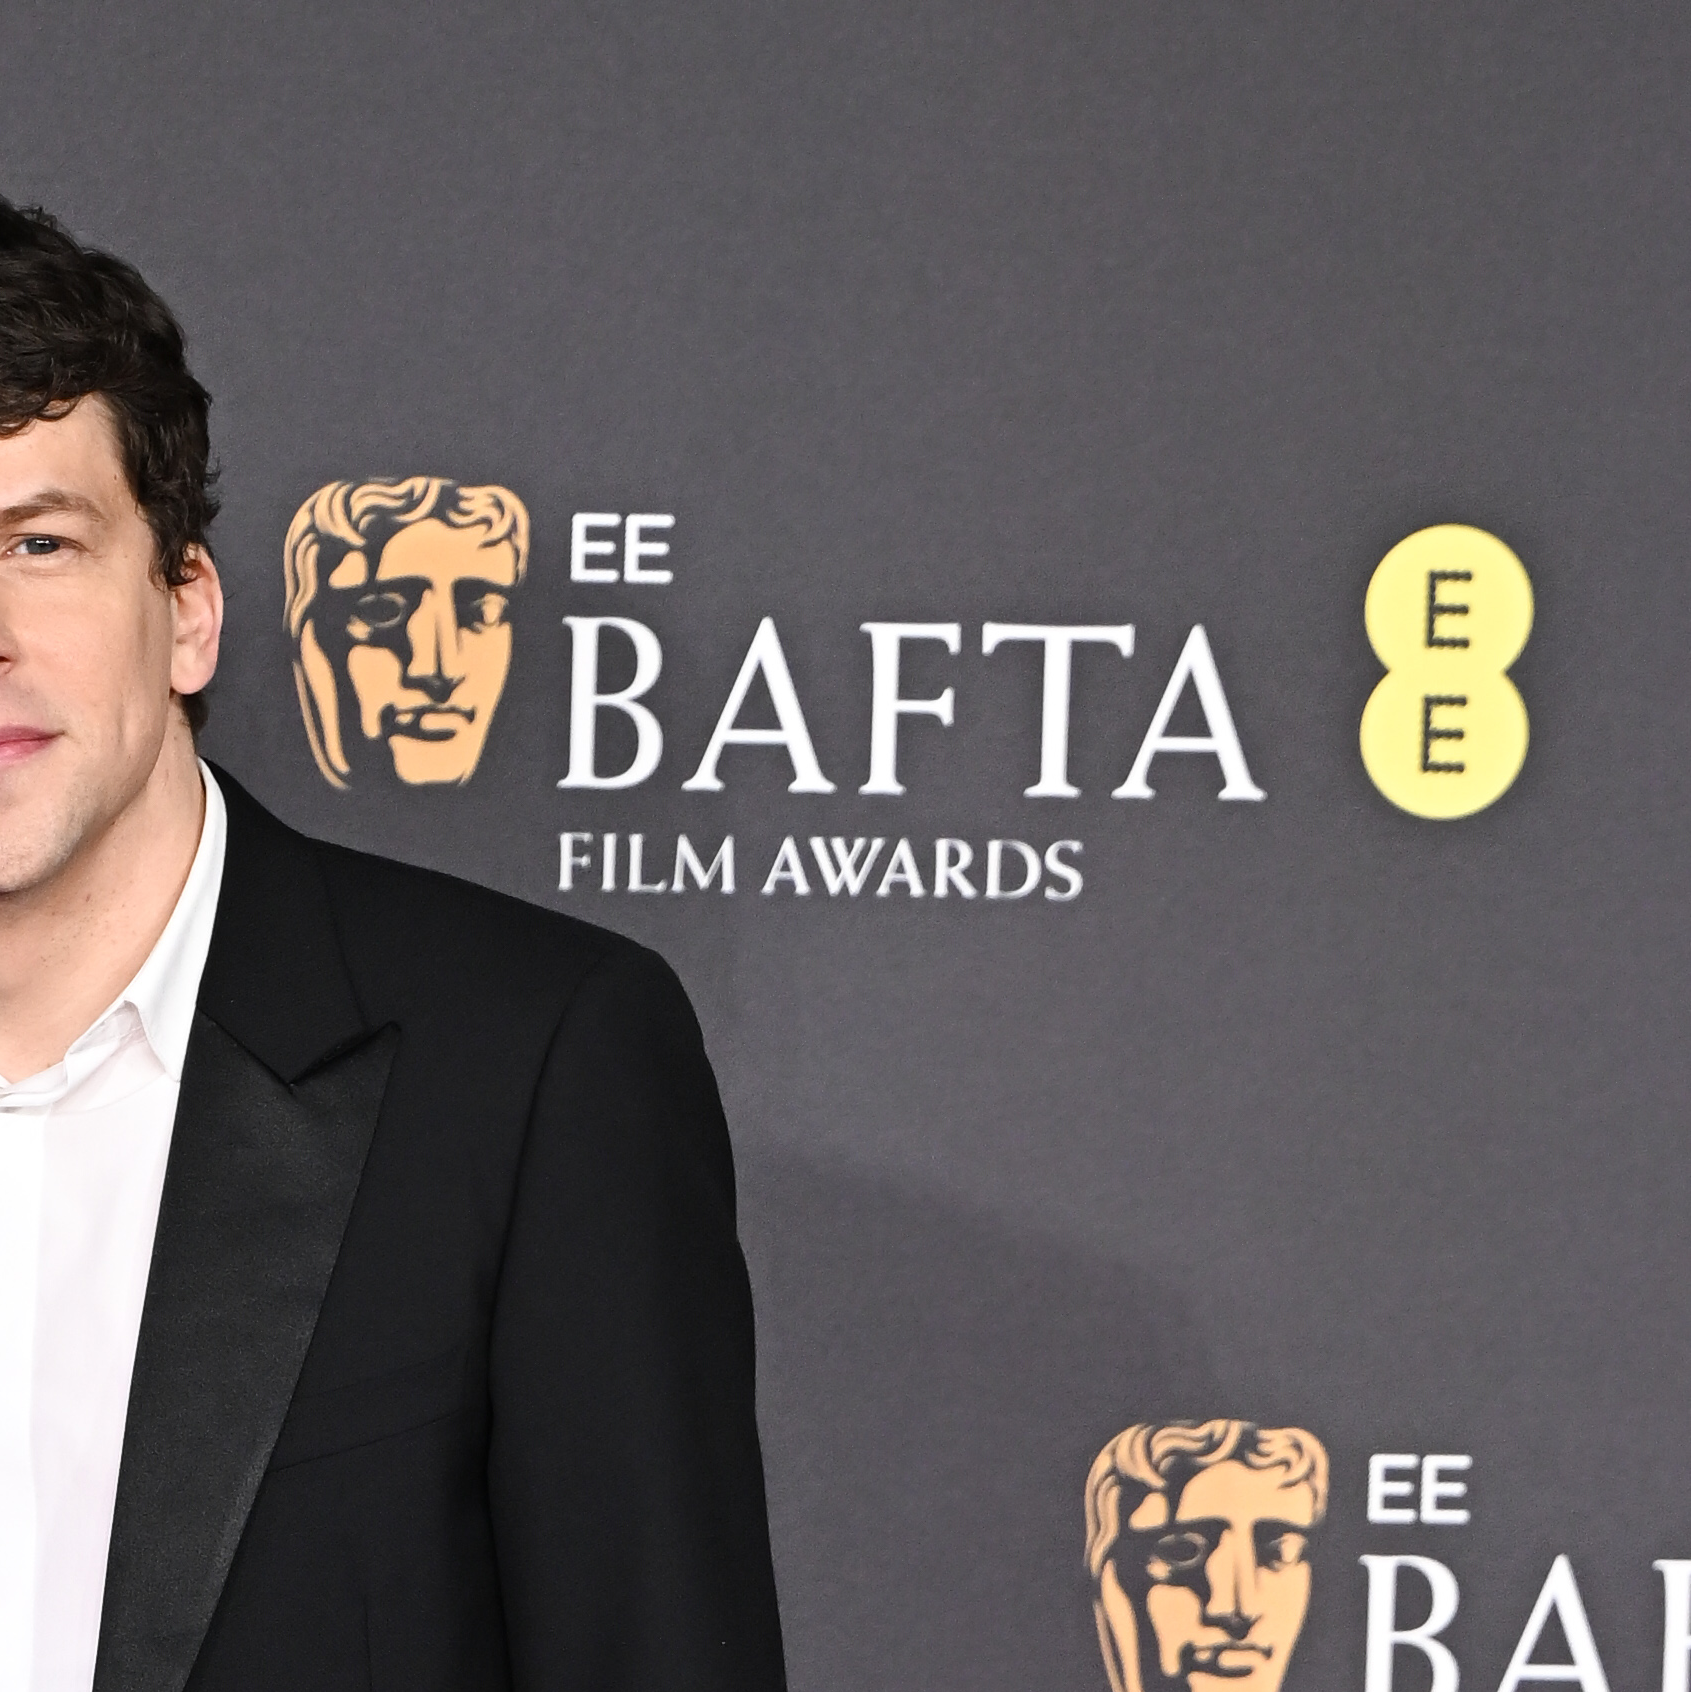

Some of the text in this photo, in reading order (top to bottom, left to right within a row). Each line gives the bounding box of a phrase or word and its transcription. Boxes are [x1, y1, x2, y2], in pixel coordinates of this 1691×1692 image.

[570, 512, 676, 585] EE
[556, 616, 1266, 802] BAFTA
[558, 832, 1084, 901] FILM AWARDS
[1366, 1453, 1473, 1525] EE
